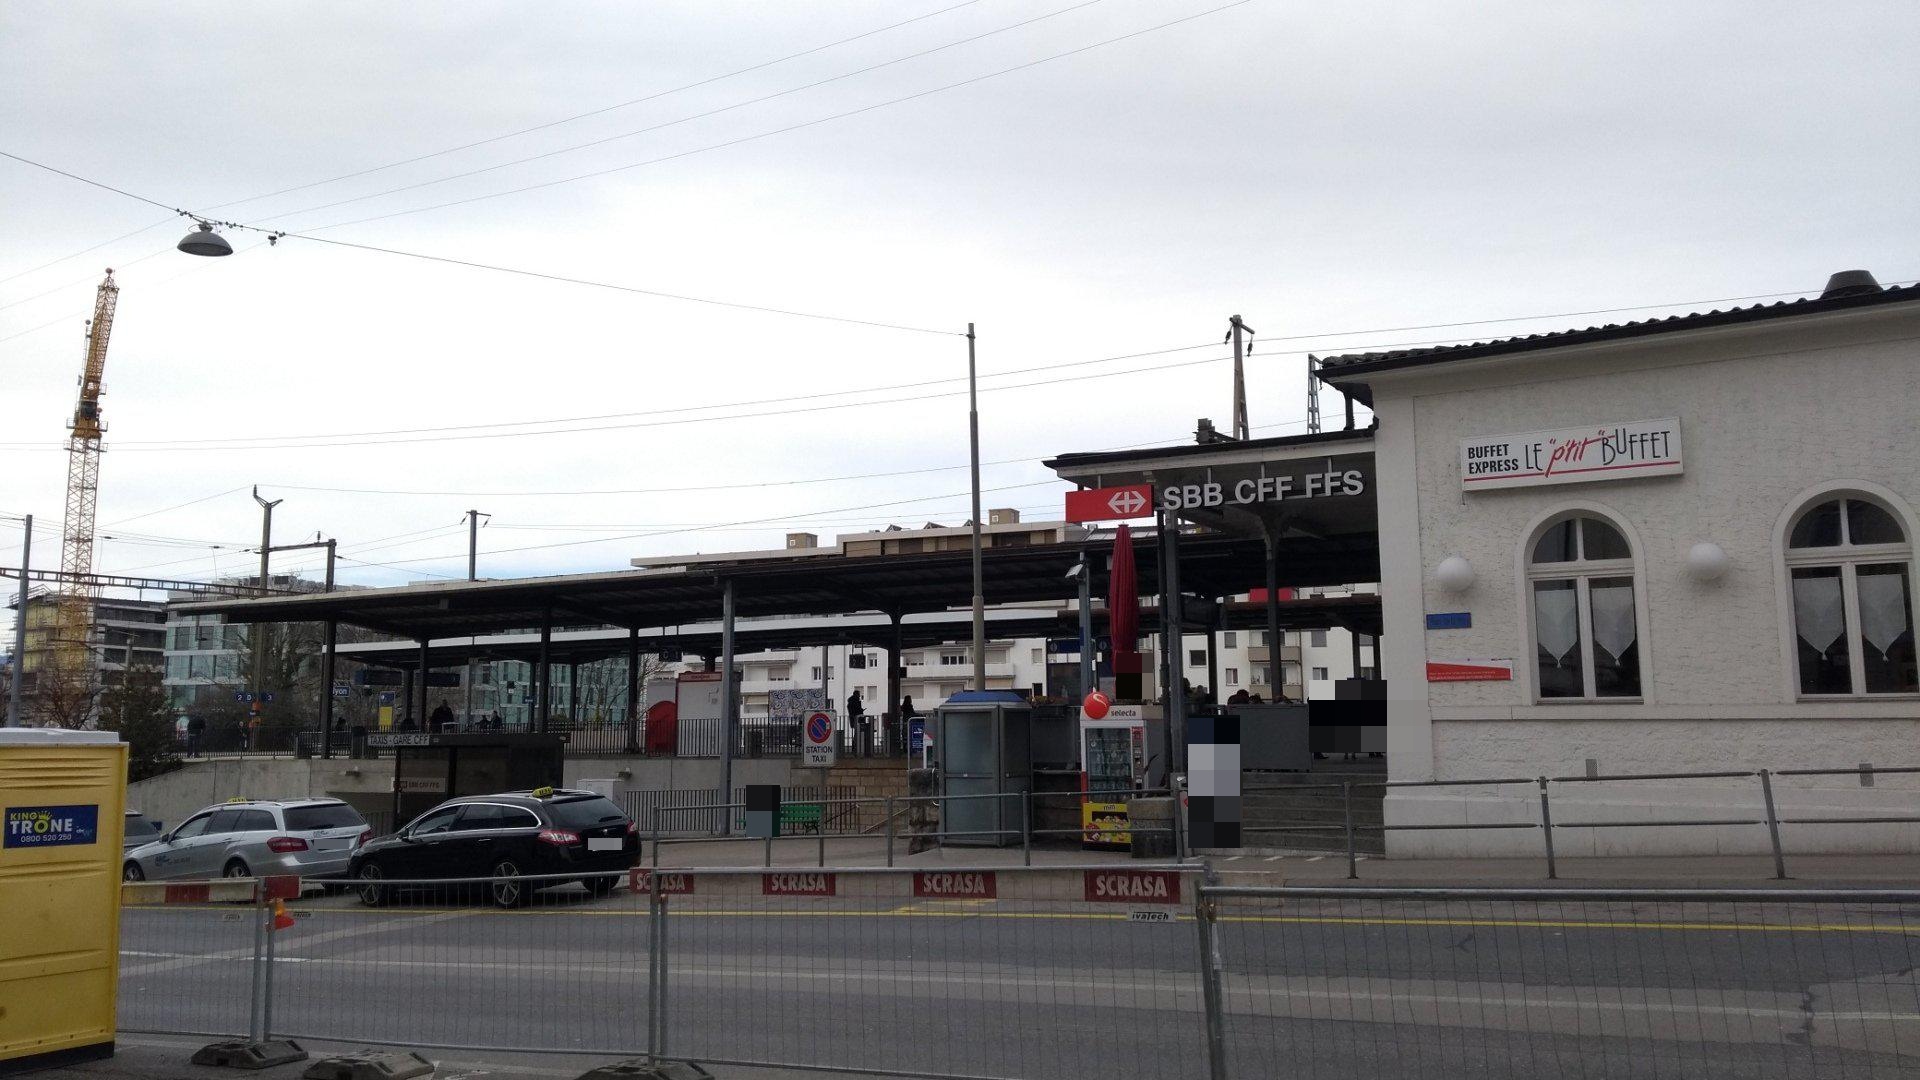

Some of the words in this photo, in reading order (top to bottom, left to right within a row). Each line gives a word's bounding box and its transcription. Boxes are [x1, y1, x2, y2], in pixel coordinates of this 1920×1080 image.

[1468, 443, 1510, 460] BUFFET
[1525, 443, 1543, 471] LE
[1602, 428, 1671, 466] BUFFET
[1468, 458, 1519, 475] EXPRESS
[1163, 482, 1223, 511] SBB
[1235, 475, 1294, 505] CFF
[1305, 469, 1364, 499] FFS
[1110, 709, 1137, 717] selecta
[369, 735, 388, 745] TAXIS
[393, 735, 412, 745] GARE
[805, 745, 833, 754] STATION
[812, 755, 827, 763] TAXI
[10, 812, 38, 821] KING
[10, 818, 73, 834] TRONE
[20, 834, 41, 843] 0800
[42, 833, 57, 842] 520
[58, 833, 72, 842] 250
[636, 872, 686, 890] SCASA
[771, 872, 827, 892] SCRASA
[923, 873, 986, 895] SCRASA
[1096, 875, 1168, 898] SCRASA
